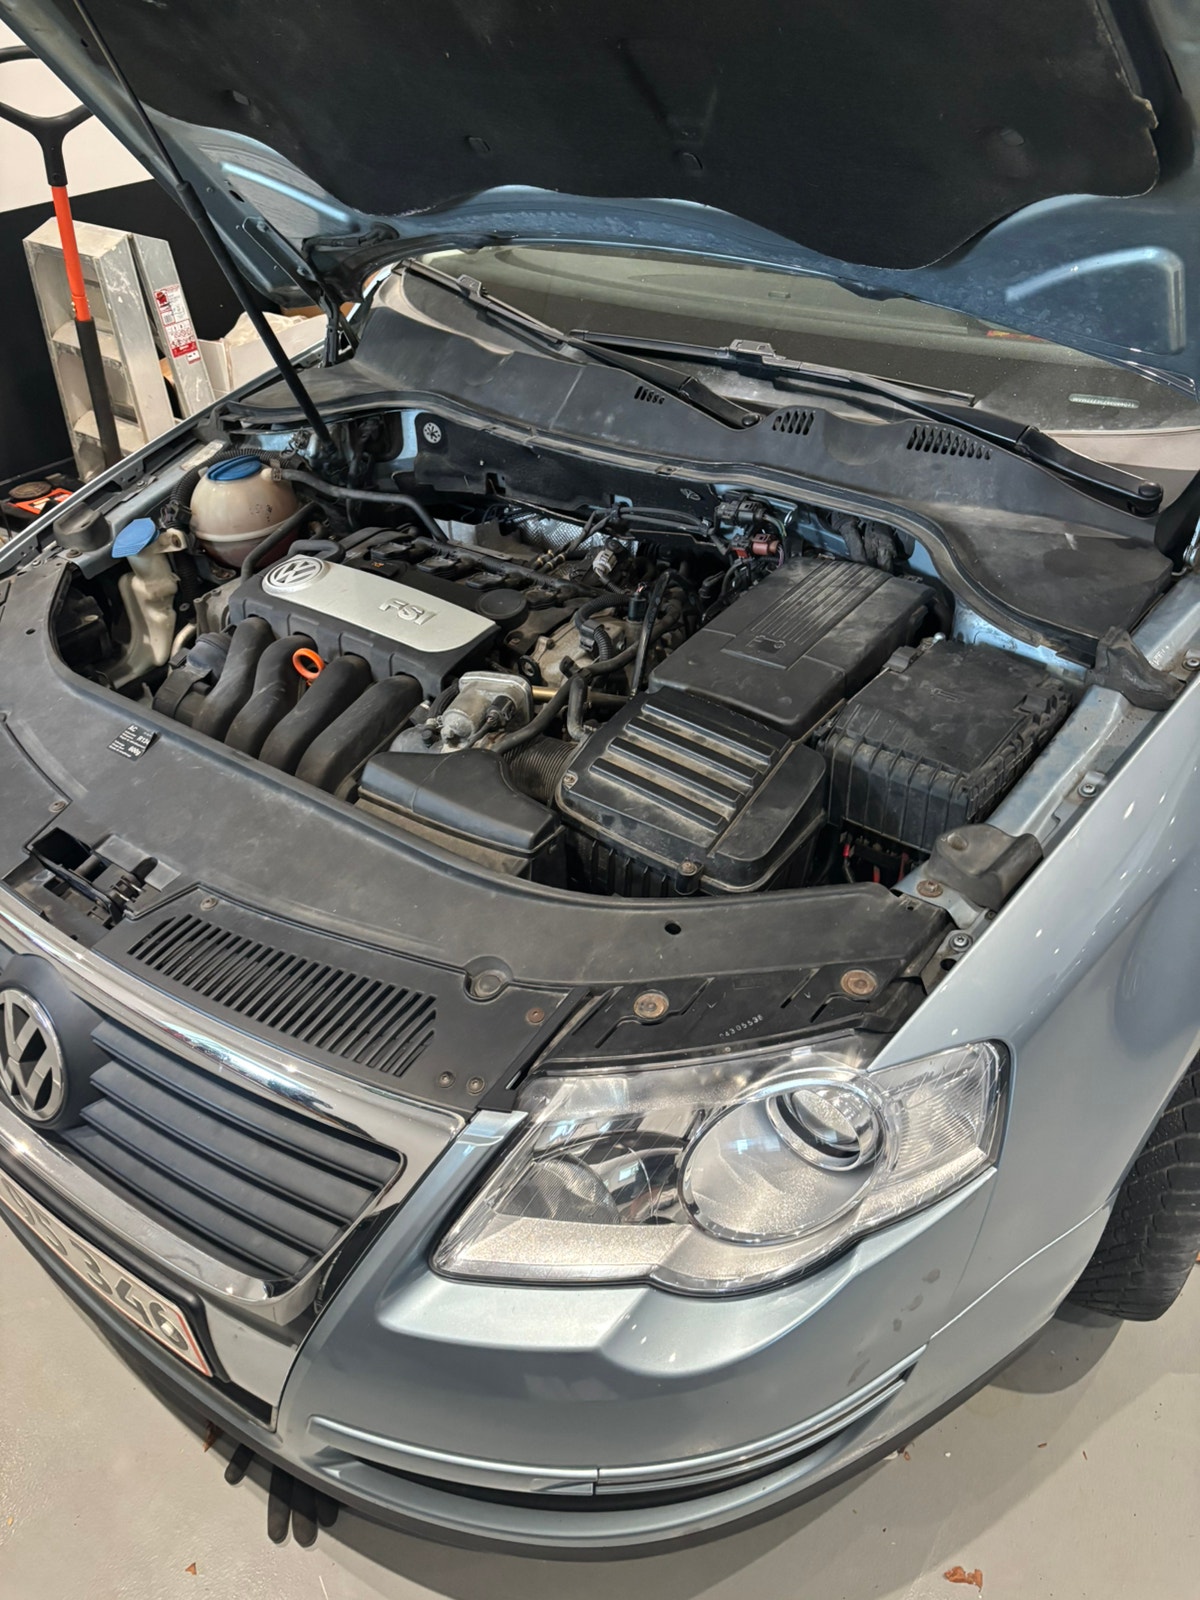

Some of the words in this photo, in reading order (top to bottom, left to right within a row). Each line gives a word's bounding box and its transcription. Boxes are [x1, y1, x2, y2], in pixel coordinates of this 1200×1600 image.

[265, 557, 324, 588] VW
[378, 598, 439, 626] FSI
[69, 1238, 189, 1351] 346
